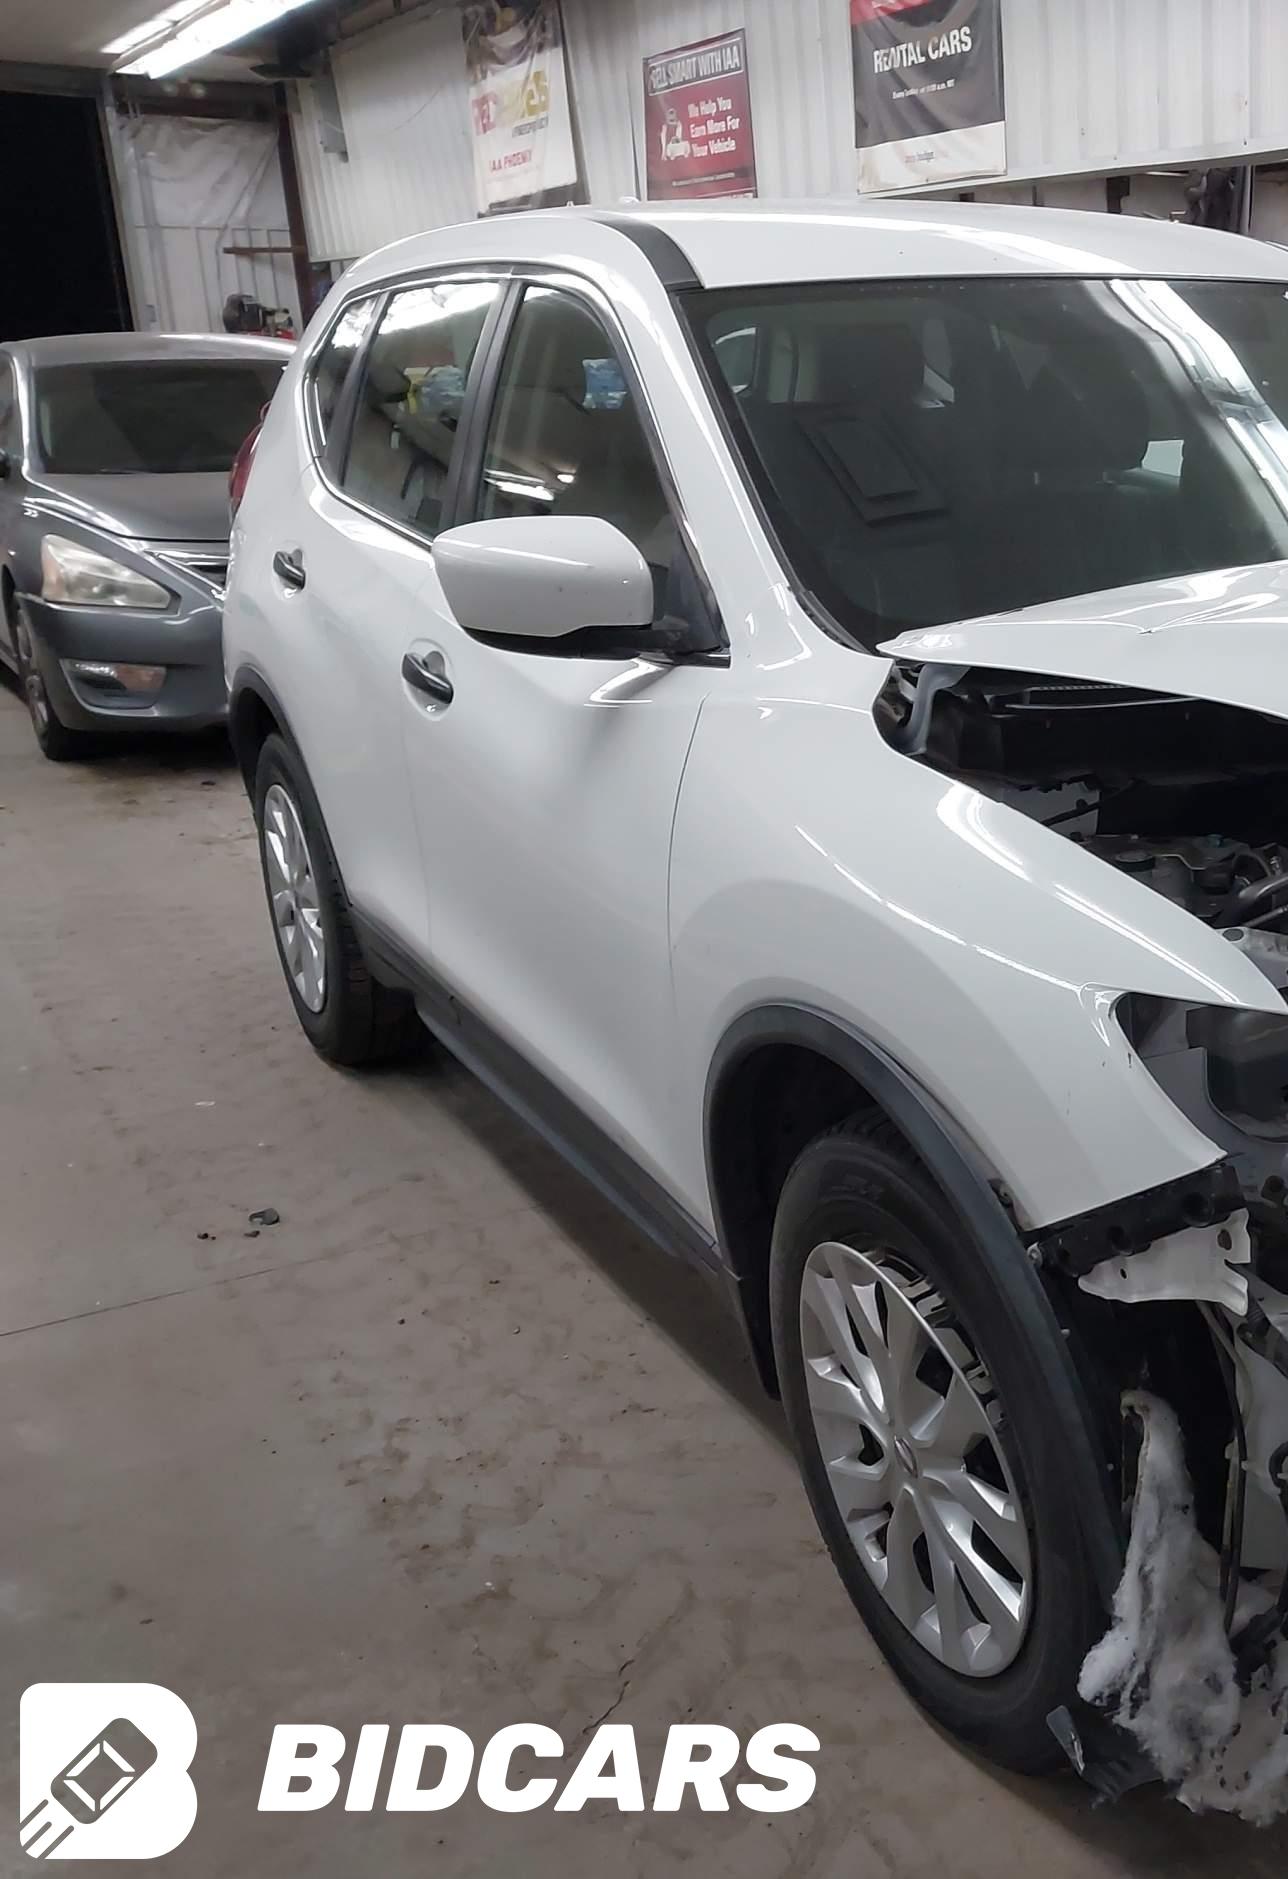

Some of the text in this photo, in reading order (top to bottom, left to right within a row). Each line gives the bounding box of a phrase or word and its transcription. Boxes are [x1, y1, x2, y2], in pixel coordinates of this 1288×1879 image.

[873, 26, 973, 74] RENTAL CARS
[668, 57, 696, 85] SMART
[698, 52, 721, 76] WITH
[722, 45, 739, 69] IAA
[700, 100, 717, 116] Help
[717, 97, 732, 111] You
[690, 116, 740, 138] Earn More For
[691, 137, 735, 158] Your Vehicle
